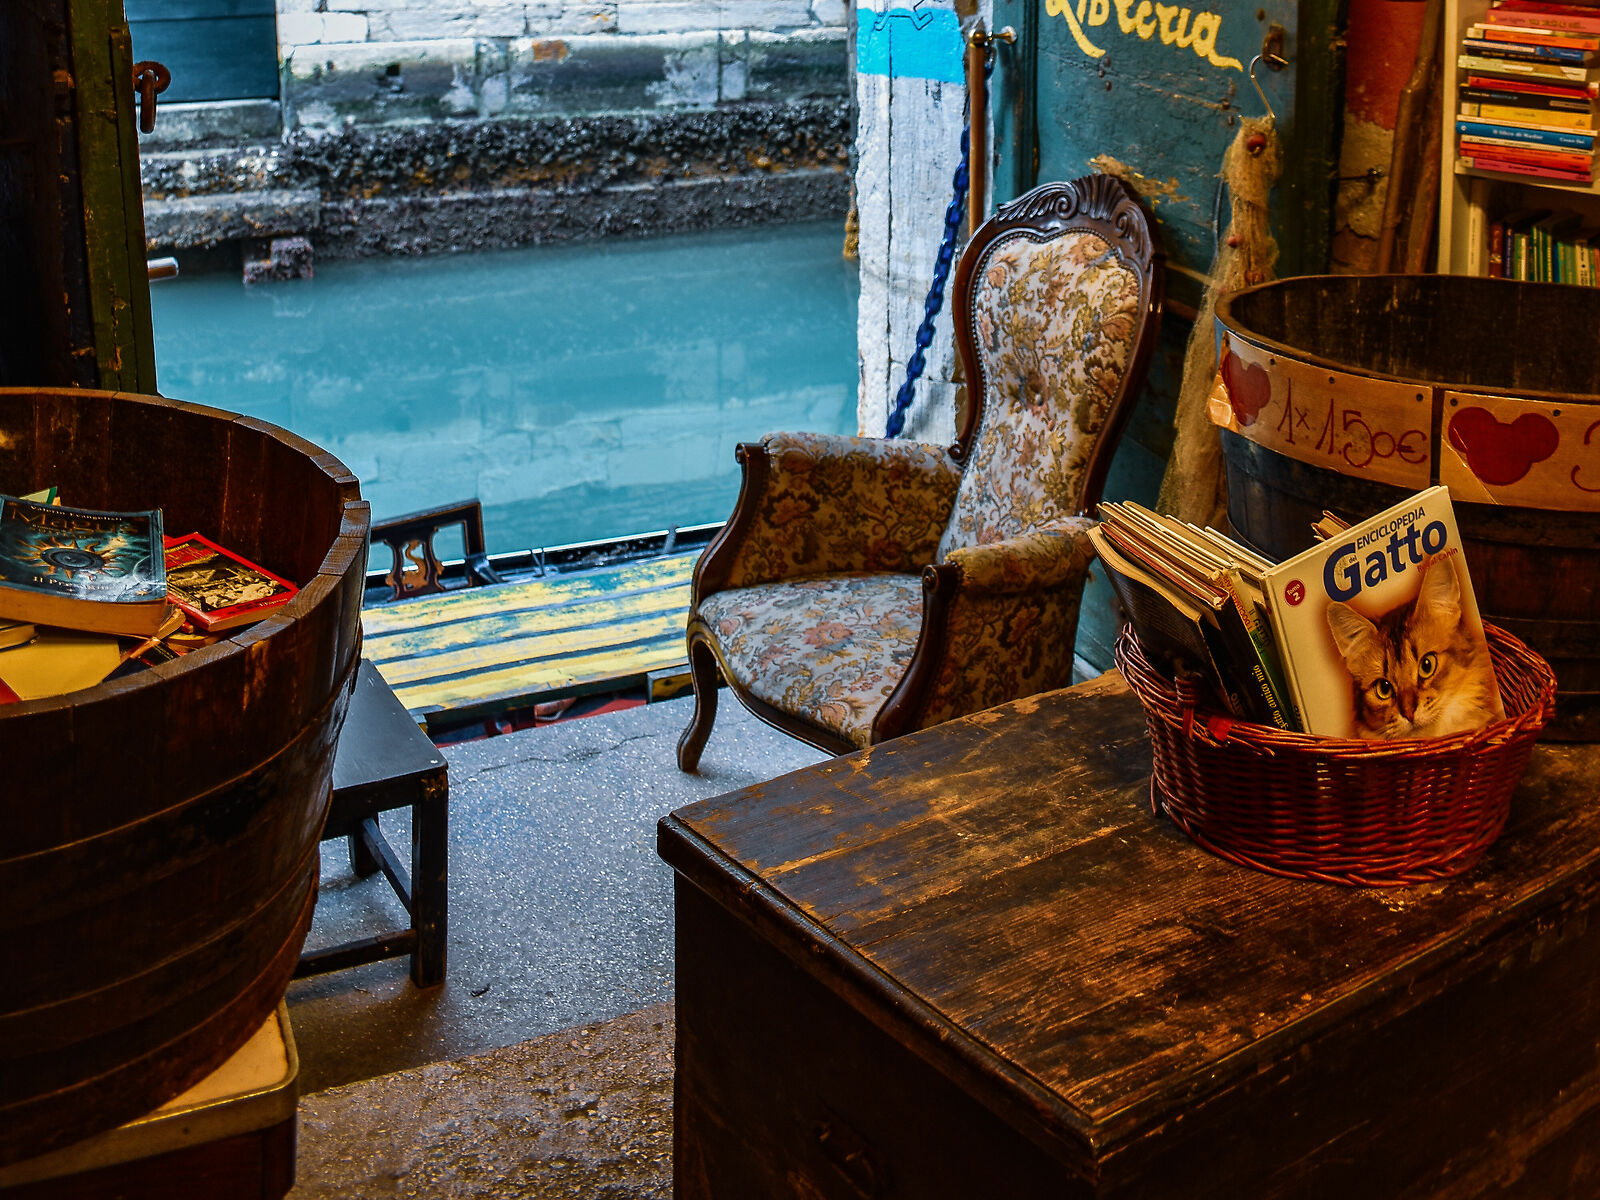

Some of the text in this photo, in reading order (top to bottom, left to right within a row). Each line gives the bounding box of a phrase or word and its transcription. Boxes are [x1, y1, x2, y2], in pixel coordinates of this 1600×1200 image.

[1356, 506, 1426, 550] ENCICLOPEDIA
[1323, 520, 1448, 603] Gatto
[1348, 555, 1358, 564] del
[1286, 583, 1301, 596] Tomo
[1293, 591, 1302, 602] 2
[1252, 663, 1266, 683] mio
[1261, 682, 1277, 709] amico
